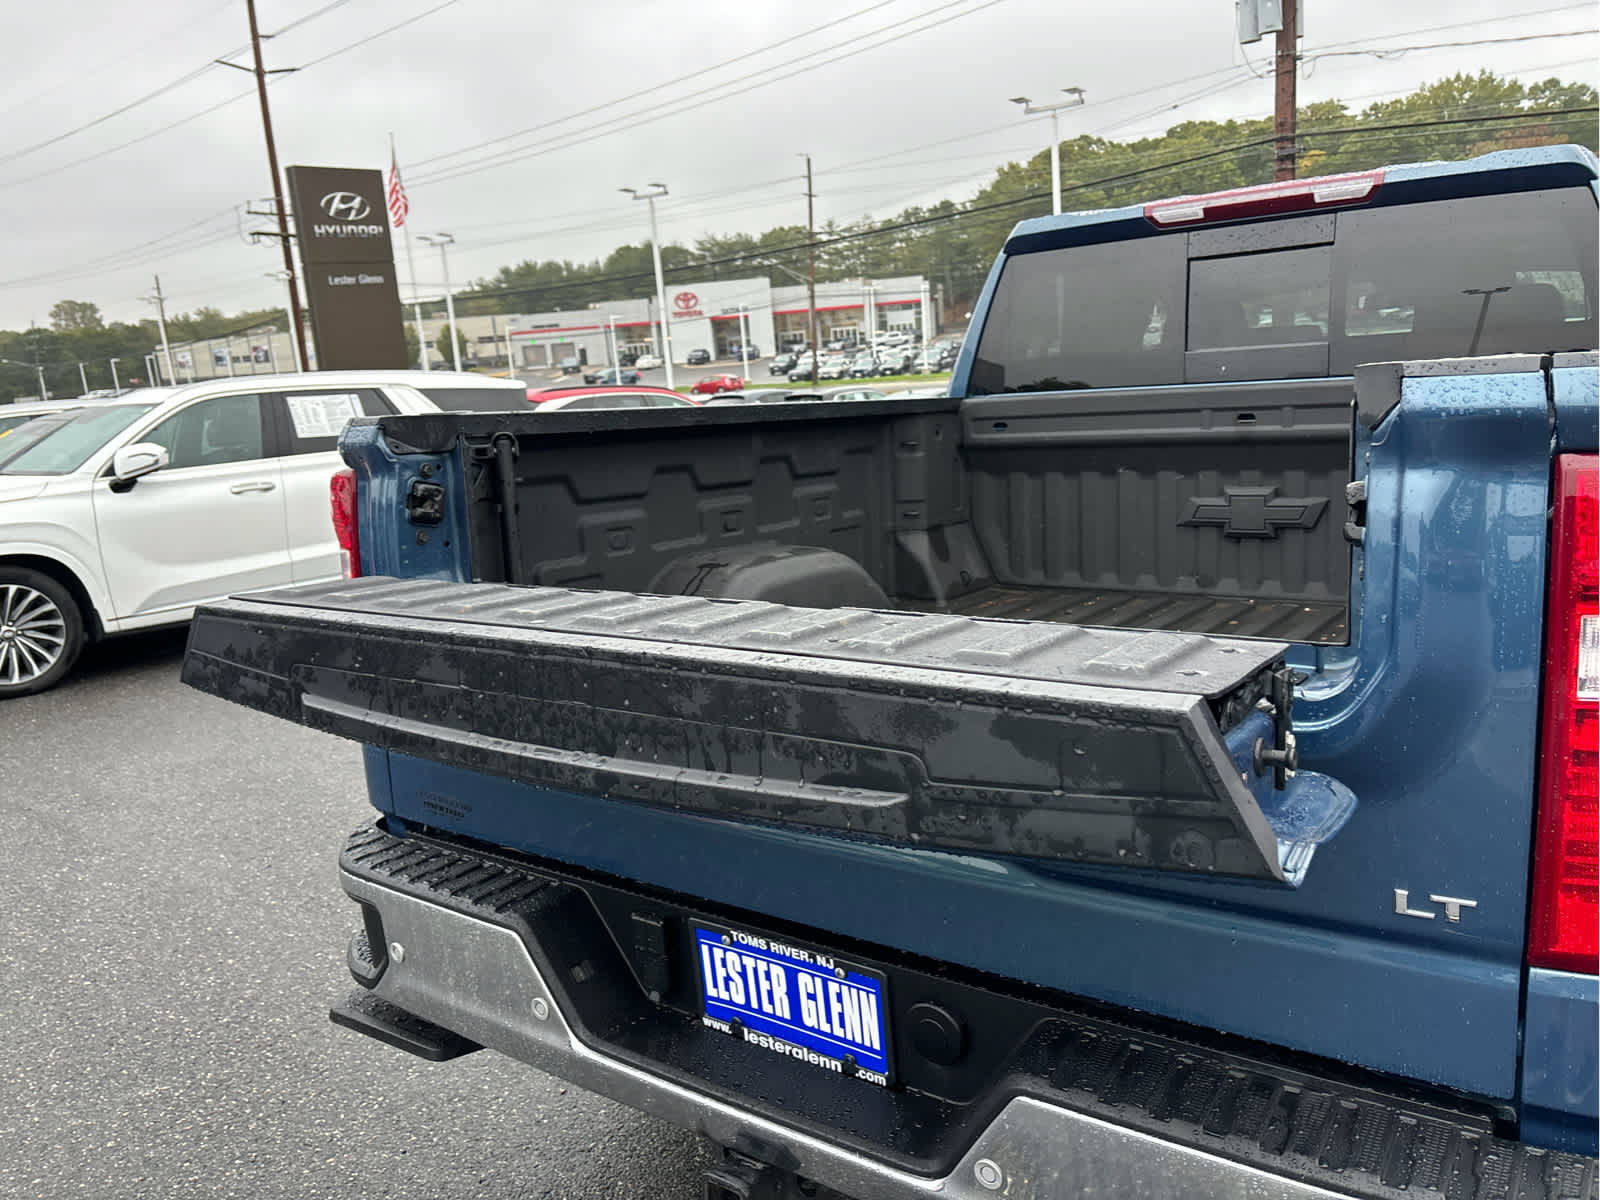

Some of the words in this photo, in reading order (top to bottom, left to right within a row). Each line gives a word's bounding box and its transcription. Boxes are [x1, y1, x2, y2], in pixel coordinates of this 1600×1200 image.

[313, 224, 384, 238] HYUNDAI
[328, 274, 357, 286] Lester
[1393, 888, 1478, 923] LT
[730, 930, 768, 951] TOMS
[769, 941, 814, 964] RIVER,
[816, 954, 835, 970] NJ
[700, 943, 791, 1021] LESTER
[797, 971, 881, 1051] GLENN
[702, 1016, 733, 1035] www.
[855, 1067, 887, 1087] .com
